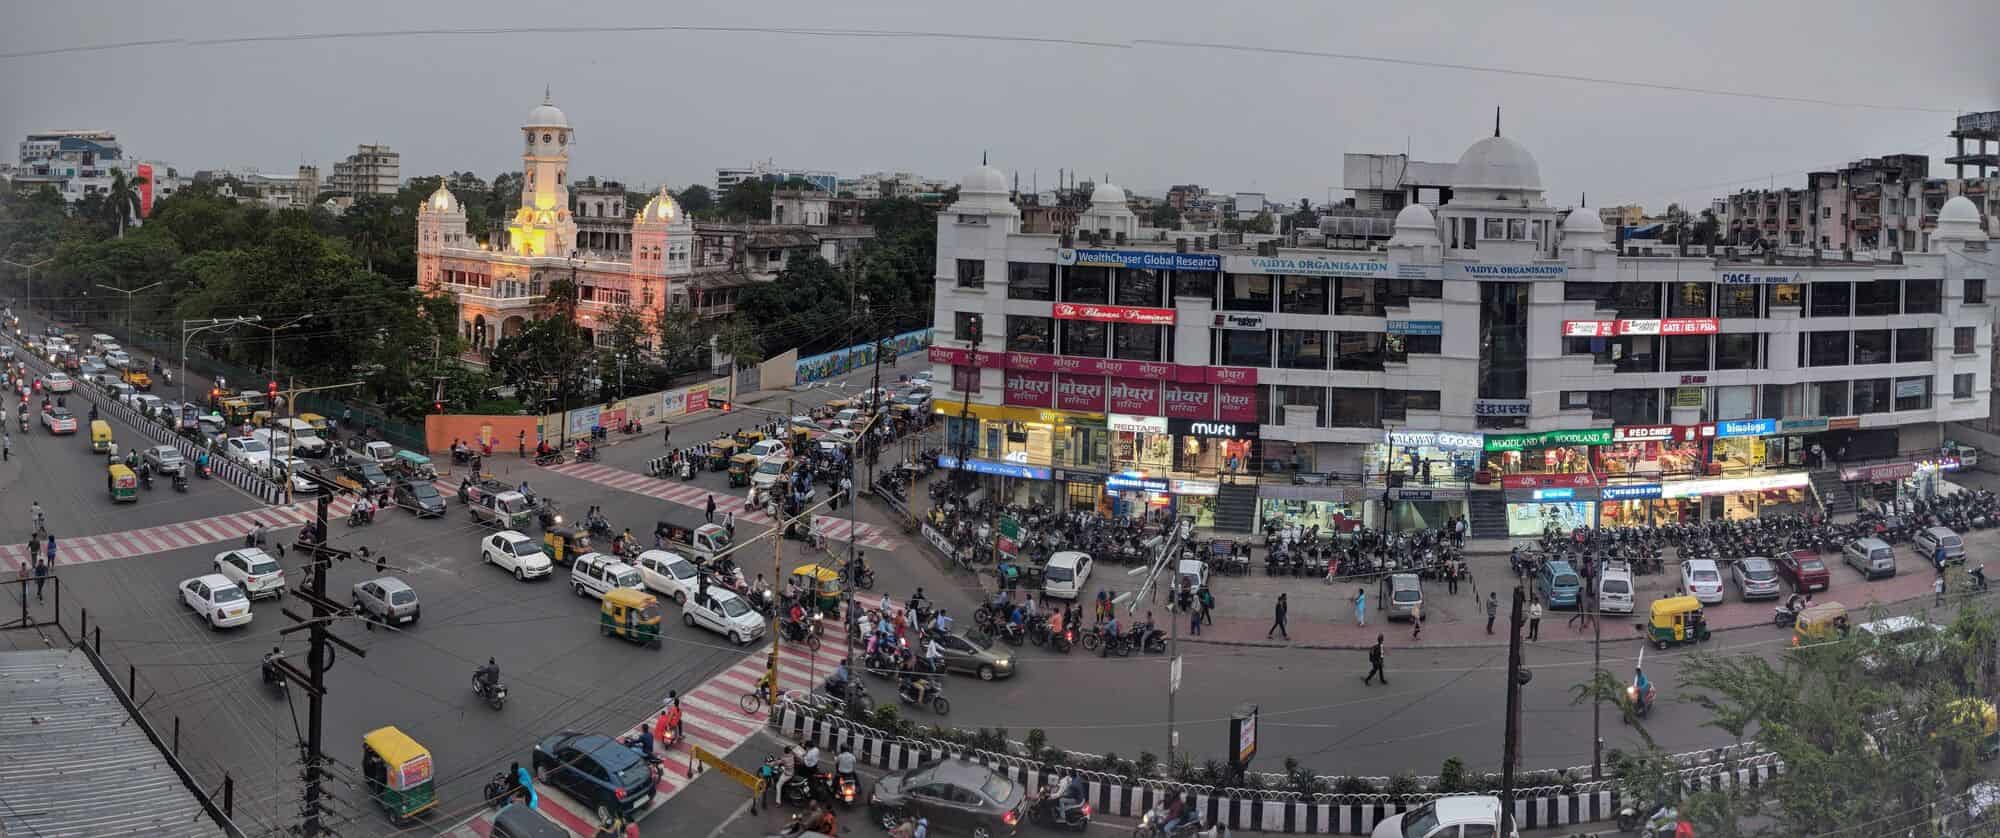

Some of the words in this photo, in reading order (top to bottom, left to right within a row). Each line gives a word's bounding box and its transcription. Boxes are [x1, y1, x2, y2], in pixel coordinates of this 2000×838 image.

[1079, 251, 1141, 264] WealthChaser
[1144, 254, 1174, 266] Global
[1176, 256, 1218, 267] Research
[1250, 258, 1295, 269] VAIDYA
[1298, 259, 1388, 272] ORGANISATION
[1464, 265, 1498, 274] VAIDYA
[1500, 266, 1563, 274] ORGANISATION
[1722, 273, 1751, 283] PACE
[1007, 375, 1049, 394] मोयरा
[1111, 382, 1155, 401] मोयरा
[1166, 386, 1209, 404] मोयरा
[1554, 432, 1600, 443] WOODLAND
[1629, 428, 1648, 437] RED
[1649, 427, 1673, 436] CHIEF
[1491, 438, 1538, 449] WOODLAND
[1005, 451, 1028, 463] 4G
